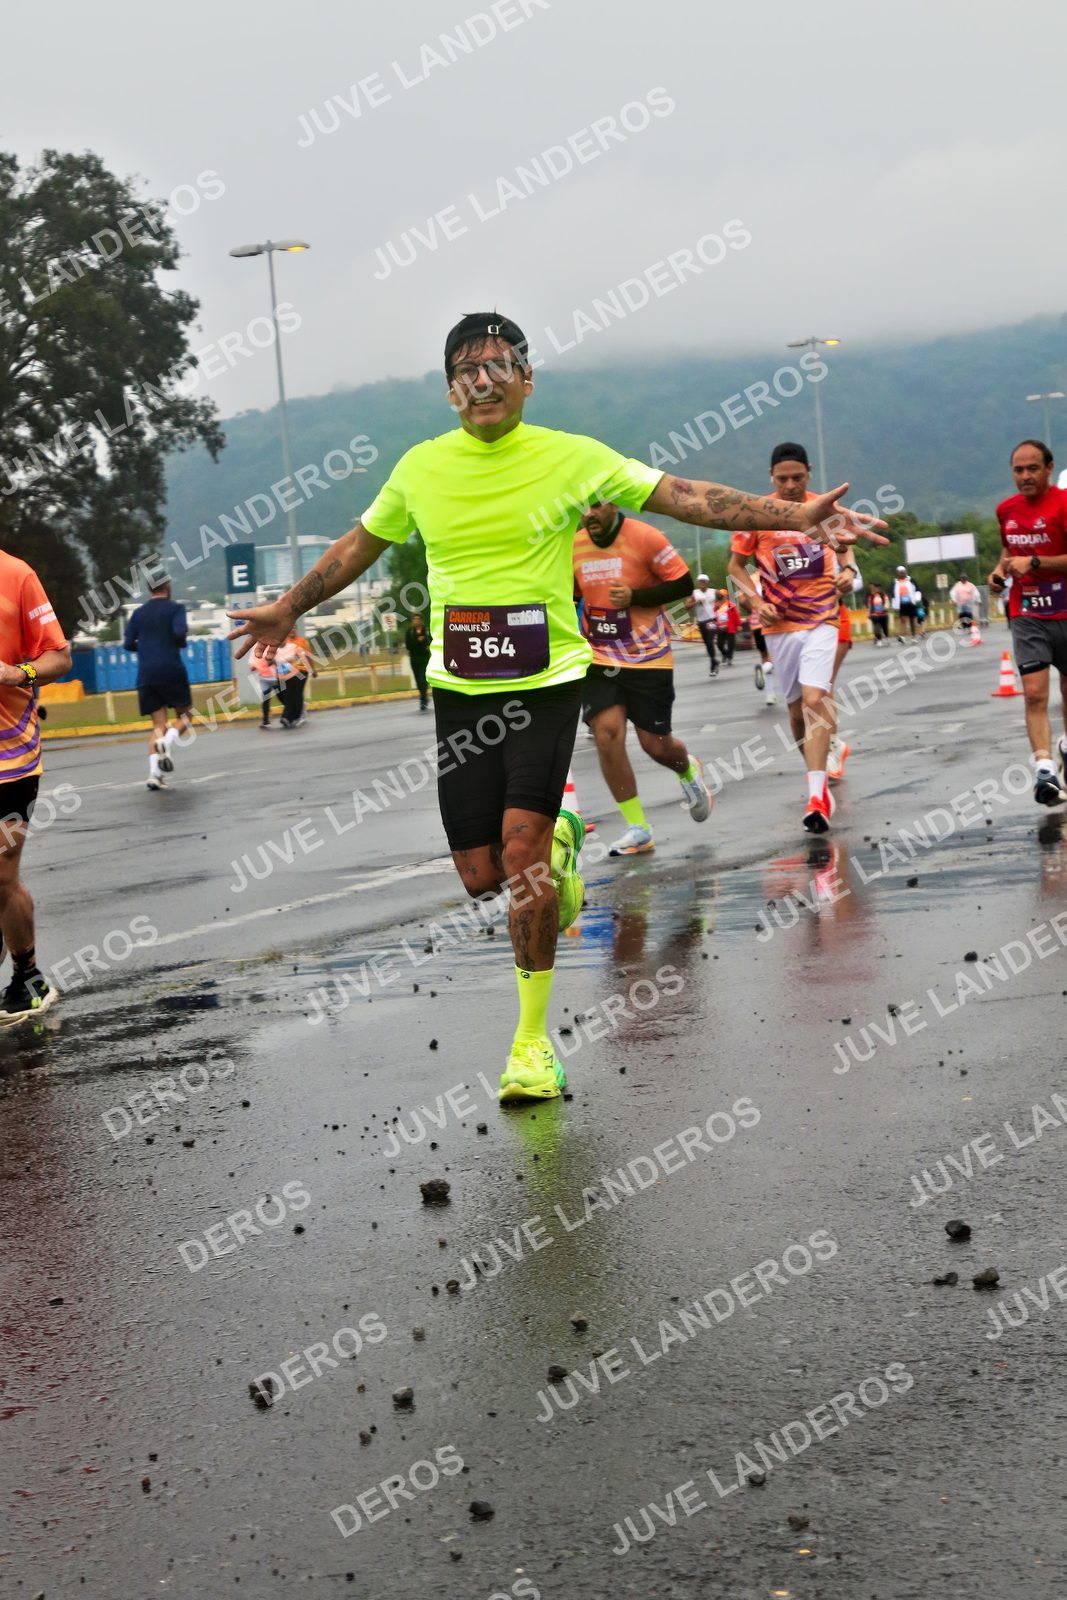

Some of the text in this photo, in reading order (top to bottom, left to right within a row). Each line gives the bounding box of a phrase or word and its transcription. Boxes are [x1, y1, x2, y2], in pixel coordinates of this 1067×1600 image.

[787, 558, 810, 569] 357
[232, 564, 249, 587] E
[1031, 596, 1052, 607] 511
[449, 611, 490, 623] CARRERA
[449, 624, 481, 632] OMNILIFE
[597, 623, 618, 634] 495
[468, 637, 516, 658] 364
